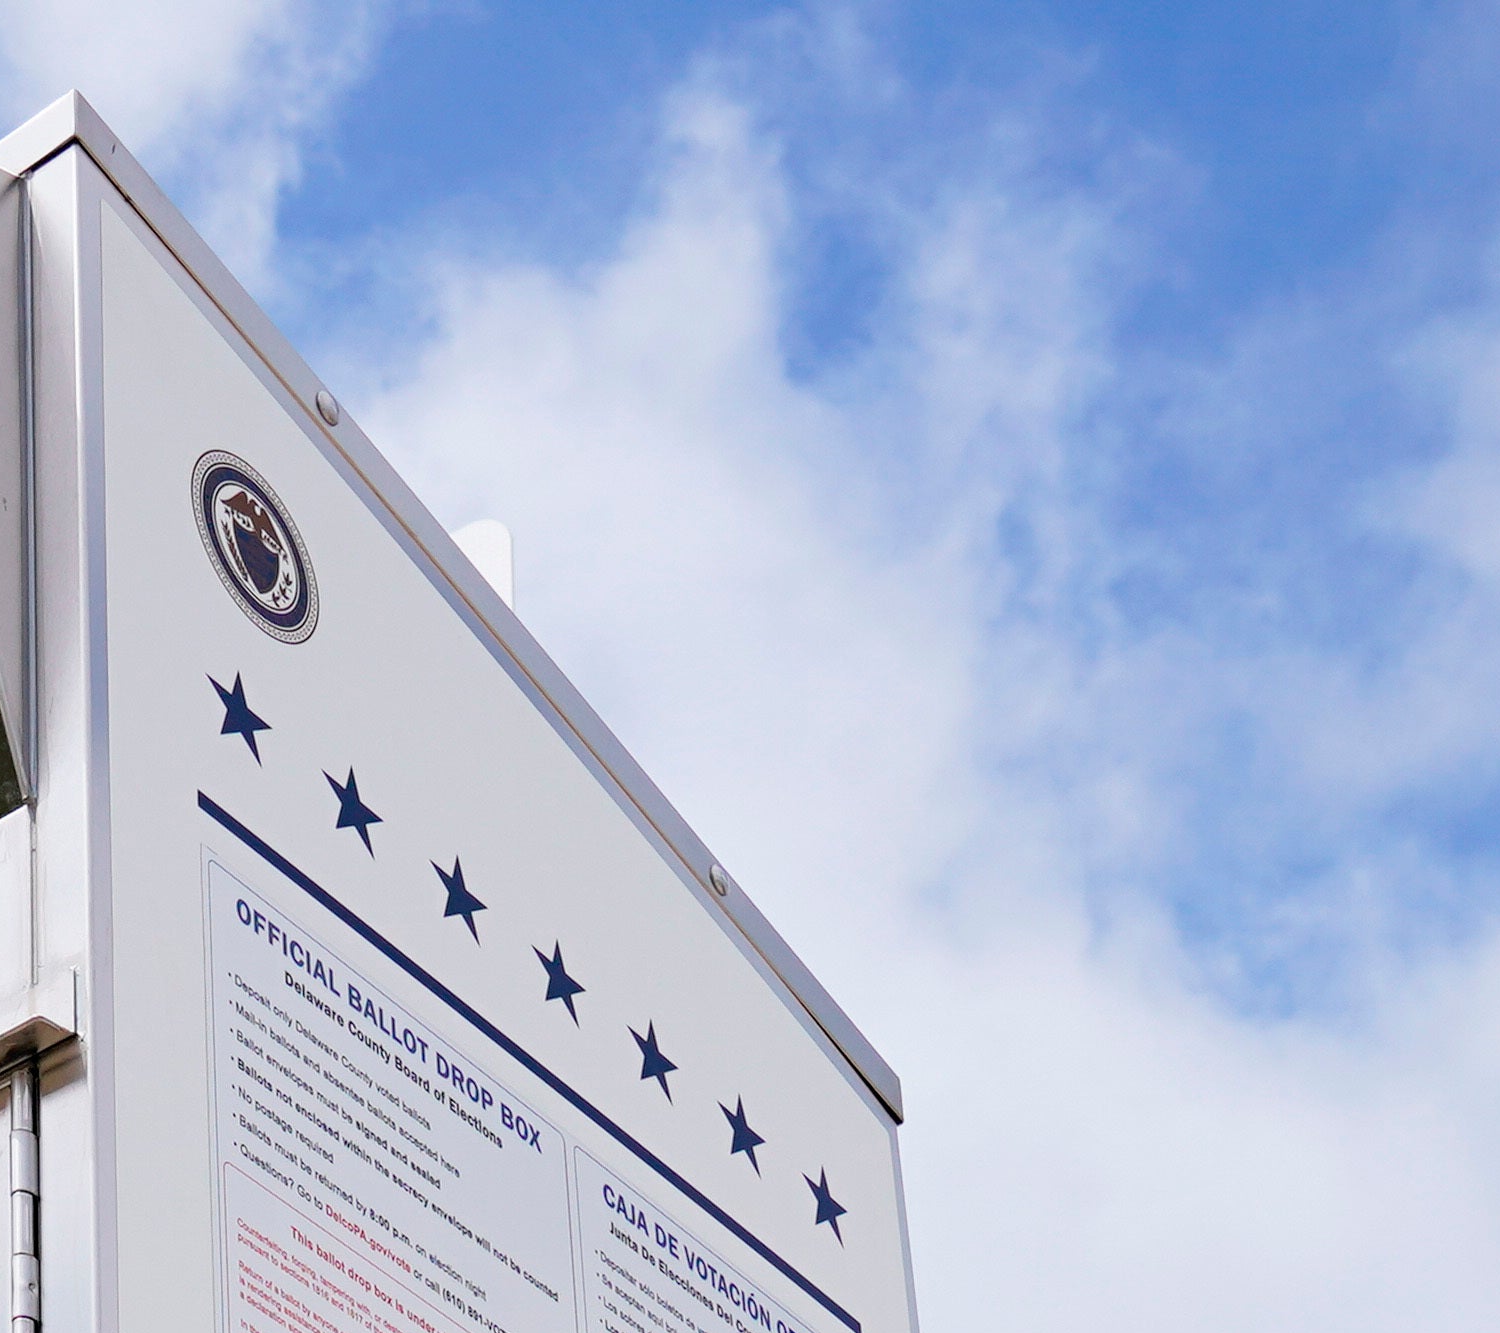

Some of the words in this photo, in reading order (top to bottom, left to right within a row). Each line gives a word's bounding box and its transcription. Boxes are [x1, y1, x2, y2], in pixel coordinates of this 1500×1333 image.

[234, 973, 272, 1011] Deposit
[272, 1005, 293, 1028] only
[295, 1019, 339, 1062] Delaware
[340, 1055, 374, 1089] County
[375, 1082, 401, 1108] voted
[401, 1100, 432, 1131] ballots
[236, 898, 341, 998] OFFICIAL
[347, 982, 429, 1064] BALLOT
[435, 1051, 494, 1111] DROP
[500, 1101, 542, 1154] BOX
[269, 1026, 301, 1059] ballots
[302, 1054, 321, 1075] and
[322, 1069, 365, 1108] absentee
[366, 1099, 397, 1132] ballots
[398, 1126, 439, 1163] accepted
[440, 1155, 461, 1179] here
[284, 970, 345, 1028] Delaware
[347, 1020, 391, 1065] County
[394, 1054, 431, 1094] Board
[433, 1088, 446, 1105] of
[448, 1096, 503, 1149] Elections
[236, 1029, 264, 1059] Ballot
[265, 1054, 314, 1096] envelopes
[316, 1091, 340, 1115] must
[341, 1107, 354, 1125] be
[355, 1120, 388, 1151] signed
[390, 1146, 409, 1166] and
[410, 1160, 441, 1191] sealed
[237, 1056, 274, 1093] Ballots
[275, 1088, 293, 1108] not
[294, 1102, 340, 1142] enclosed
[341, 1136, 372, 1166] within
[374, 1158, 390, 1179] the
[391, 1173, 429, 1209] secrecy
[431, 1202, 473, 1240] envelope
[474, 1234, 491, 1253] will
[492, 1248, 509, 1266] not
[509, 1257, 521, 1275] be
[522, 1270, 559, 1303] counted
[238, 1085, 253, 1105] No
[254, 1100, 293, 1135] postage
[295, 1129, 334, 1165] required
[239, 1113, 272, 1147] Ballots
[274, 1142, 299, 1167] must
[299, 1157, 313, 1176] be
[314, 1170, 354, 1206] returned
[355, 1197, 368, 1217] by
[392, 1226, 413, 1249] p.m.
[415, 1243, 427, 1259] on
[428, 1253, 464, 1285] election
[464, 1279, 487, 1302] night
[240, 1143, 295, 1190] Questions?
[296, 1183, 312, 1203] Go
[313, 1195, 324, 1211] to
[413, 1269, 423, 1282] or
[424, 1277, 441, 1295] call
[290, 1225, 314, 1252] This
[316, 1243, 346, 1275] ballot
[347, 1267, 372, 1293] drop
[373, 1283, 393, 1308] box
[395, 1298, 405, 1315] is
[602, 1183, 650, 1238] CAJA
[654, 1221, 680, 1261] DE
[683, 1244, 772, 1332] VOTACIÓN
[609, 1221, 639, 1254] Junta
[641, 1244, 656, 1267] De
[657, 1258, 715, 1312] Elecciones
[716, 1303, 734, 1327] Del
